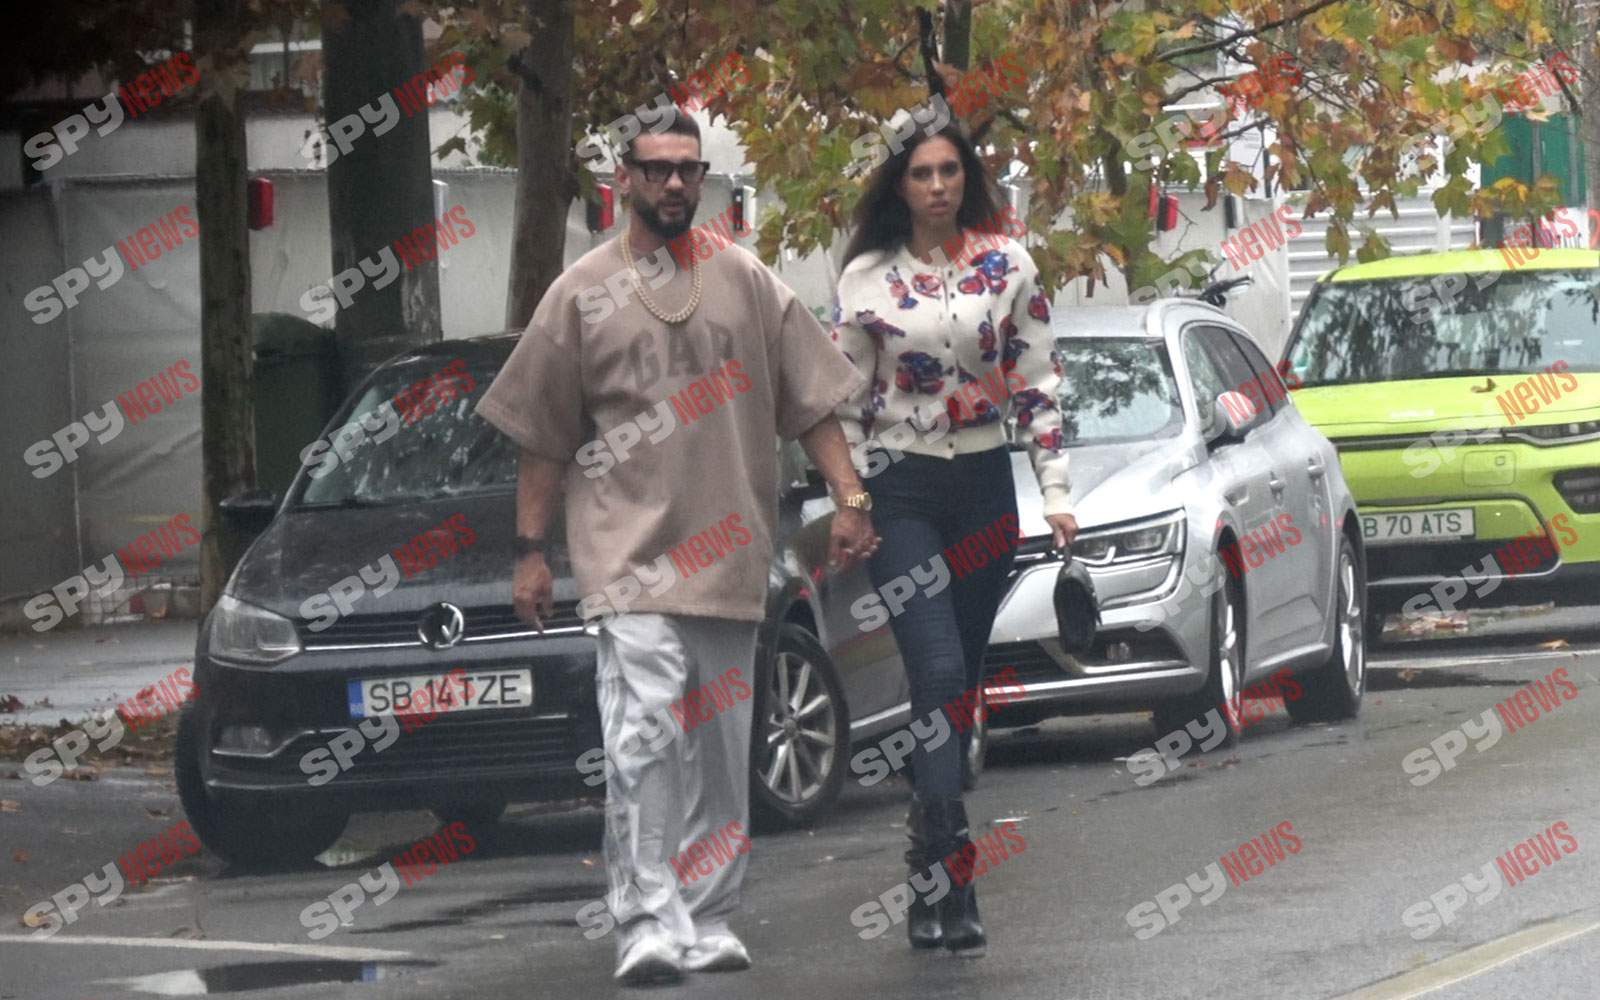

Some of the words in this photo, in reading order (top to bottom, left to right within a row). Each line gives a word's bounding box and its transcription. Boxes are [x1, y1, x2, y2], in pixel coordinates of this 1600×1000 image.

[1363, 517, 1378, 538] B
[1386, 515, 1412, 536] 70
[1421, 512, 1462, 534] ATS
[369, 681, 412, 712] SB
[424, 675, 452, 708] 14
[459, 673, 521, 706] TZE
